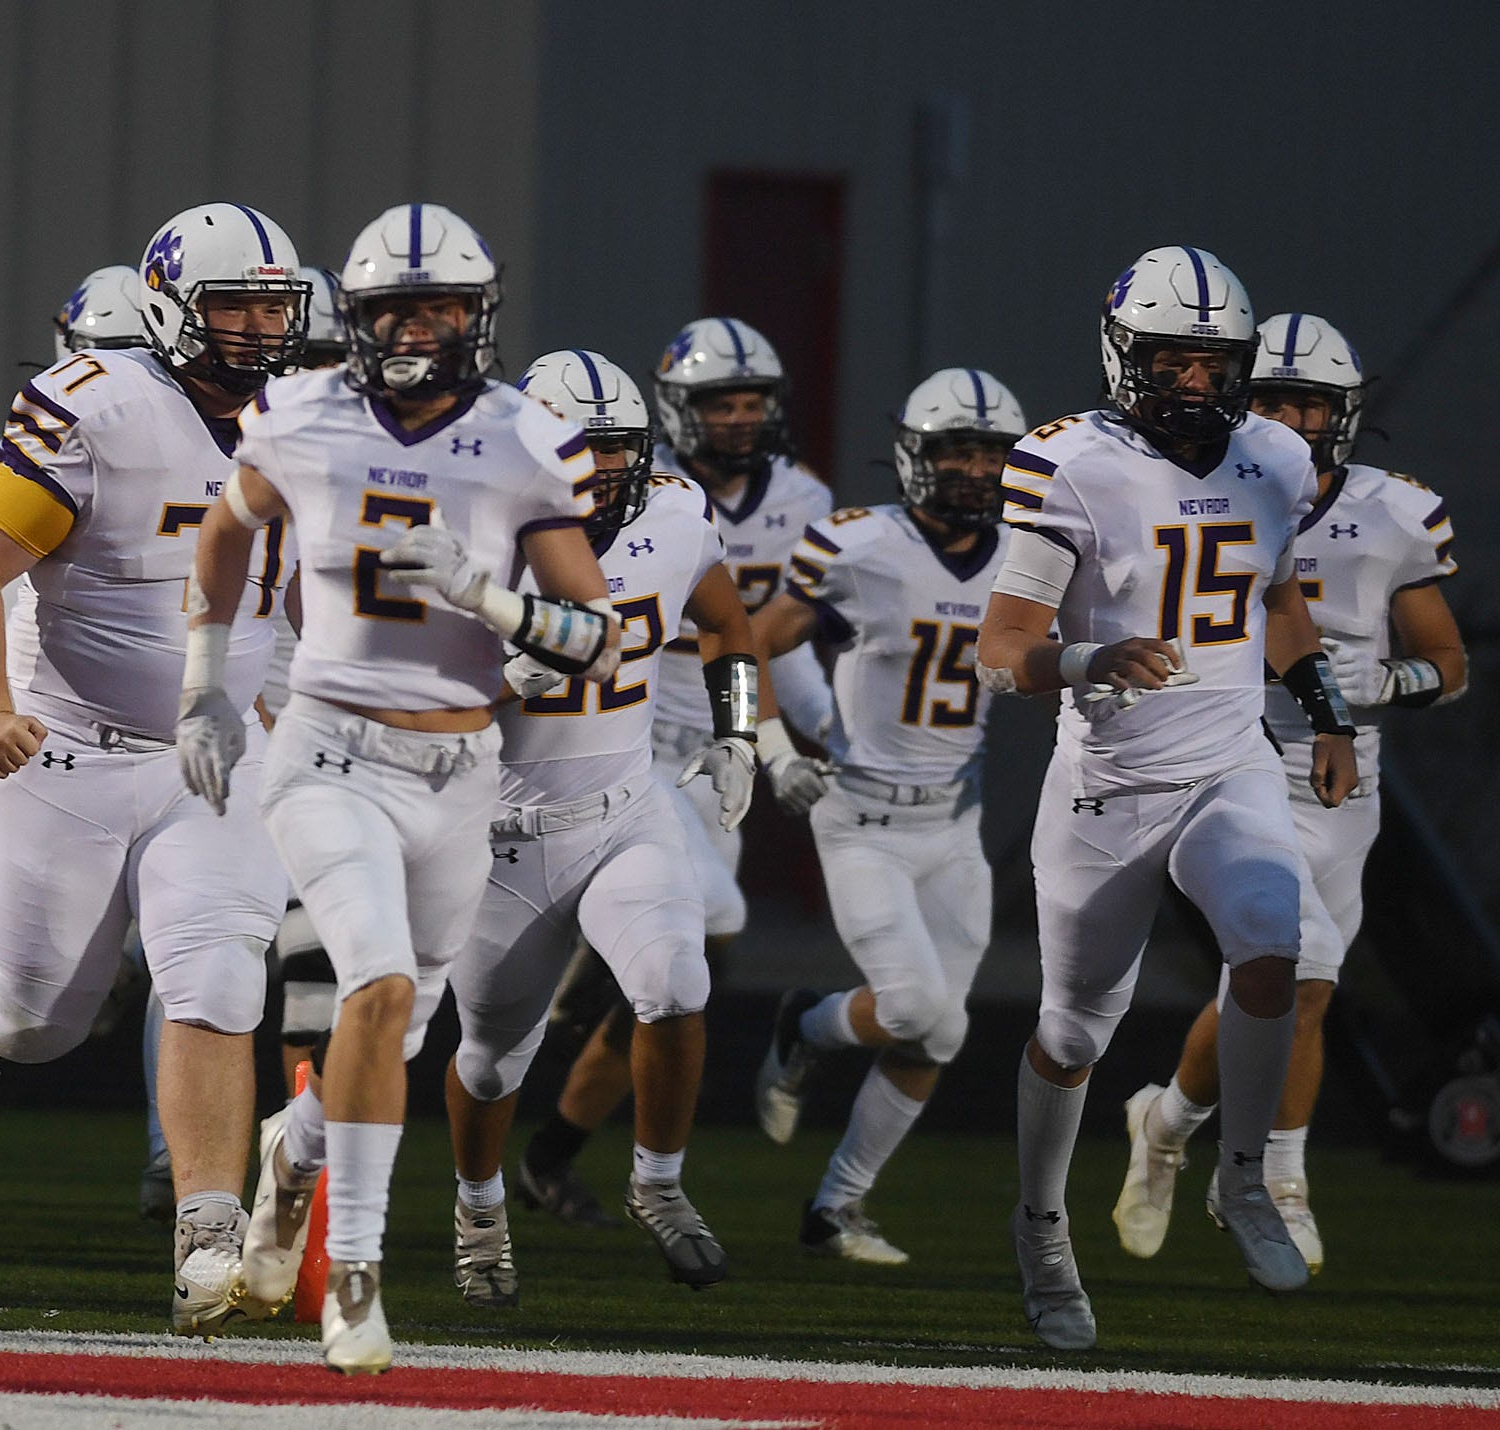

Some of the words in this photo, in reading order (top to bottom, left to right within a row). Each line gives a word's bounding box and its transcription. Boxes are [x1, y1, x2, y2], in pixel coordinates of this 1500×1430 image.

[368, 467, 429, 489] NEVADA
[1179, 498, 1231, 516] NEVADA
[1152, 520, 1258, 648] 15
